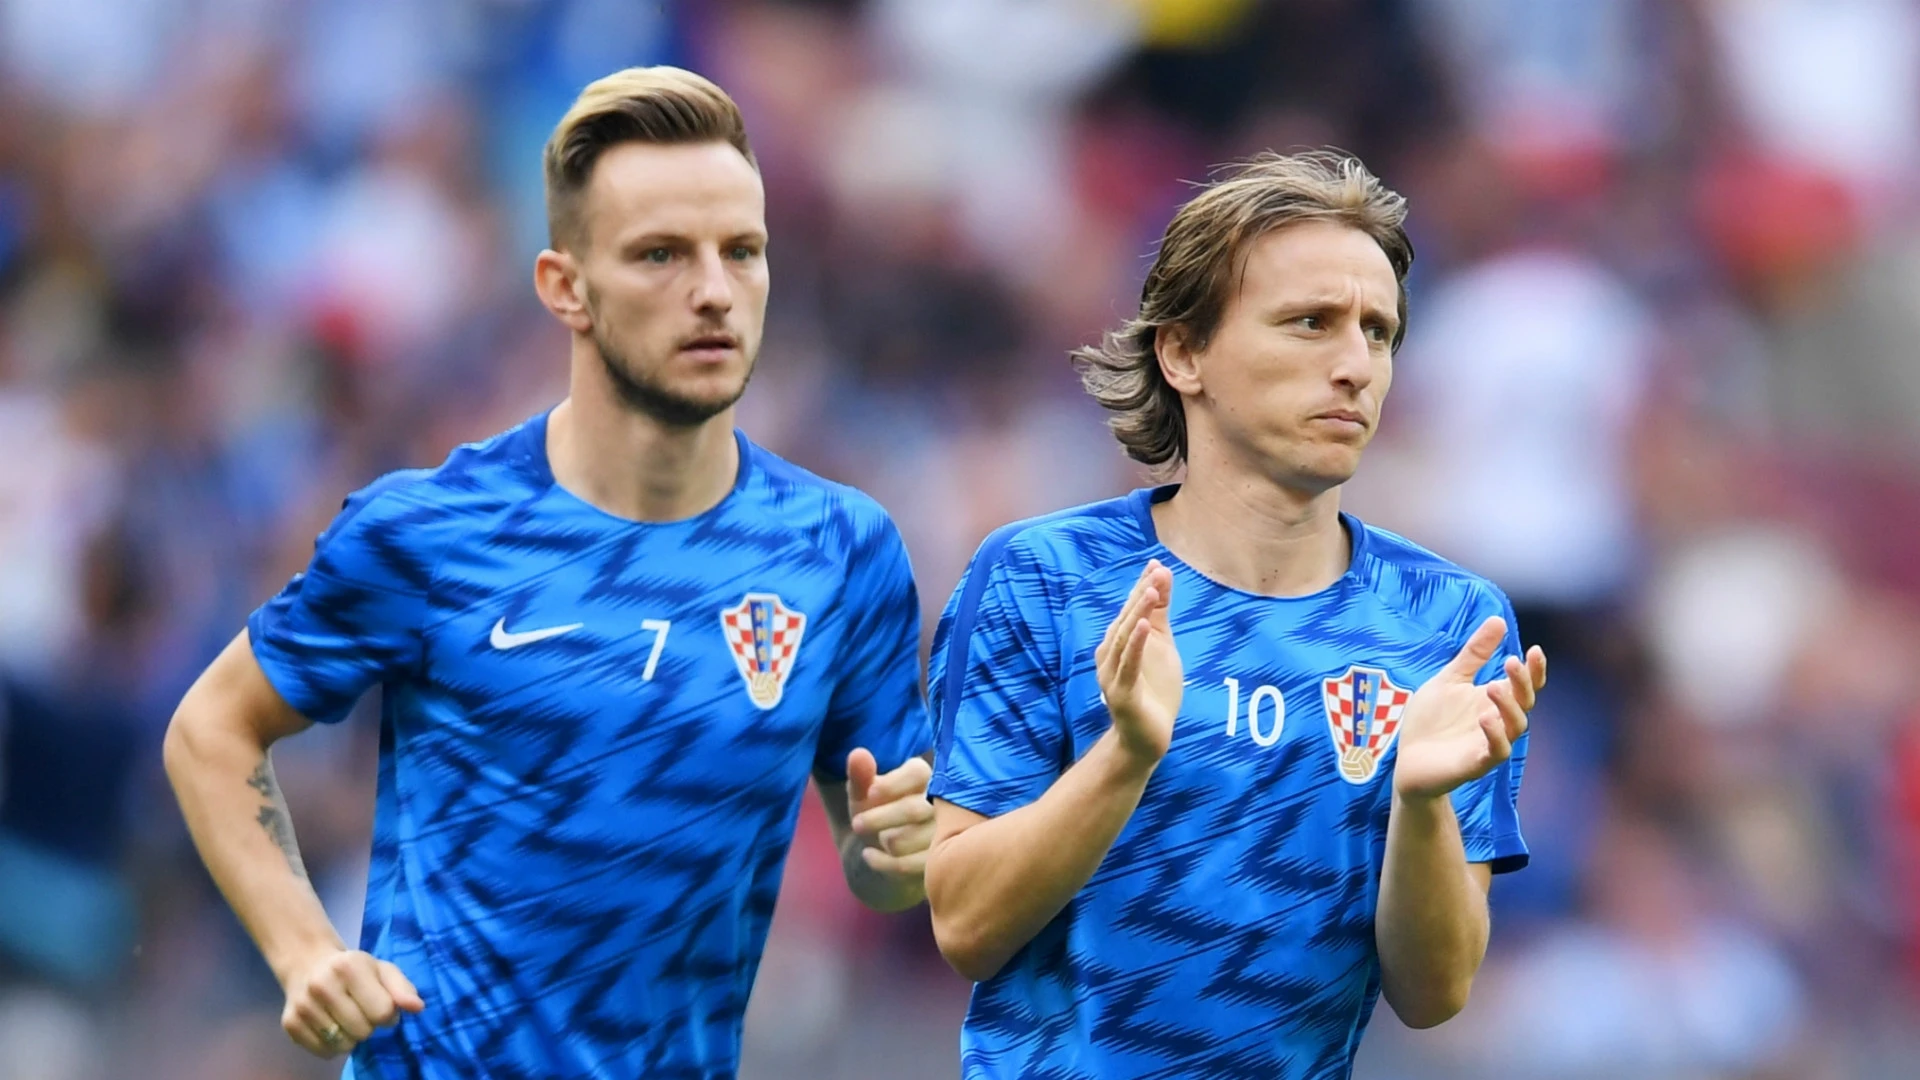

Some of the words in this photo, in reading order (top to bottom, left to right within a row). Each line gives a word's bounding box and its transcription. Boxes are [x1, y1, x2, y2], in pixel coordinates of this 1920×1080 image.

[641, 619, 671, 681] 7
[1223, 676, 1285, 747] 10
[1356, 679, 1372, 735] HNS
